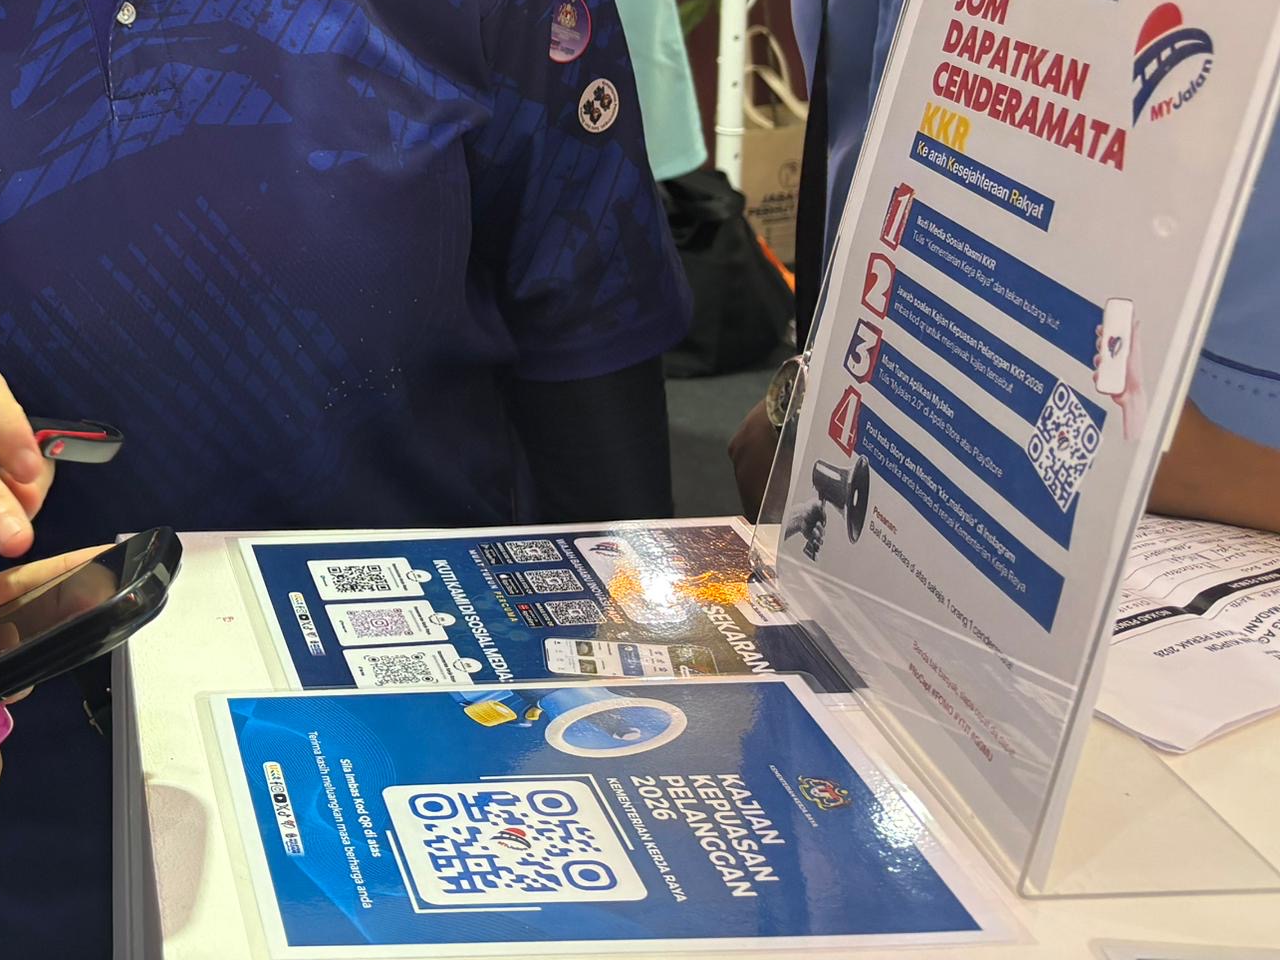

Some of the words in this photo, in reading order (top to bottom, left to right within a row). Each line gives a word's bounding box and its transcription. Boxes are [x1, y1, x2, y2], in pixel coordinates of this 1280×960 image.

[942, 19, 1091, 102] DAPATKAN
[1150, 58, 1213, 122] MYJalan
[920, 102, 973, 153] KKR
[932, 61, 1128, 172] CENDERAMATA
[916, 140, 928, 158] Ke
[928, 150, 948, 168] arah
[947, 156, 1009, 201] Kesejahteraan
[1009, 189, 1044, 219] Rakyat
[884, 193, 911, 247] 1
[928, 222, 946, 241] Media
[946, 233, 964, 252] Sosial
[963, 243, 983, 263] Rasmi
[982, 252, 997, 271] KKR
[864, 257, 893, 313] 2
[993, 282, 1006, 296] dan
[847, 322, 878, 378] 3
[931, 308, 949, 329] Kajian
[949, 318, 977, 349] Kepuasan
[977, 340, 1010, 371] Pelanggan
[1010, 362, 1025, 381] KKR
[908, 377, 932, 400] Aplikasi
[835, 392, 858, 446] 4
[432, 559, 463, 581] IKUTI
[468, 549, 485, 567] MUAT
[480, 569, 498, 590] TURUN
[493, 591, 518, 622] PERCUMA
[445, 581, 471, 605] KAMI
[457, 604, 475, 614] DI
[464, 615, 491, 648] SOSIAL
[704, 604, 776, 675] SEKARAN
[1181, 632, 1213, 650] PERAK
[483, 648, 515, 683] MEDIA:
[1153, 645, 1180, 658] 2026
[308, 731, 321, 756] Terima
[316, 755, 330, 775] kasih
[340, 758, 352, 773] Sila
[321, 775, 344, 823] meluangkan
[345, 773, 360, 798] Imbas
[630, 775, 678, 820] 2026
[353, 797, 368, 815] Kod
[357, 814, 373, 832] QR
[716, 774, 786, 844] KAJIAN
[337, 823, 351, 845] masa
[364, 829, 378, 839] di
[606, 777, 653, 843] KEMENTERIAN
[643, 841, 671, 874] KERJA
[662, 869, 688, 902] RAYA
[659, 775, 758, 897] PELANGGAN
[688, 774, 780, 881] KEPUASAN
[344, 846, 364, 885] berharga
[368, 839, 381, 858] atas
[357, 885, 373, 909] anda
